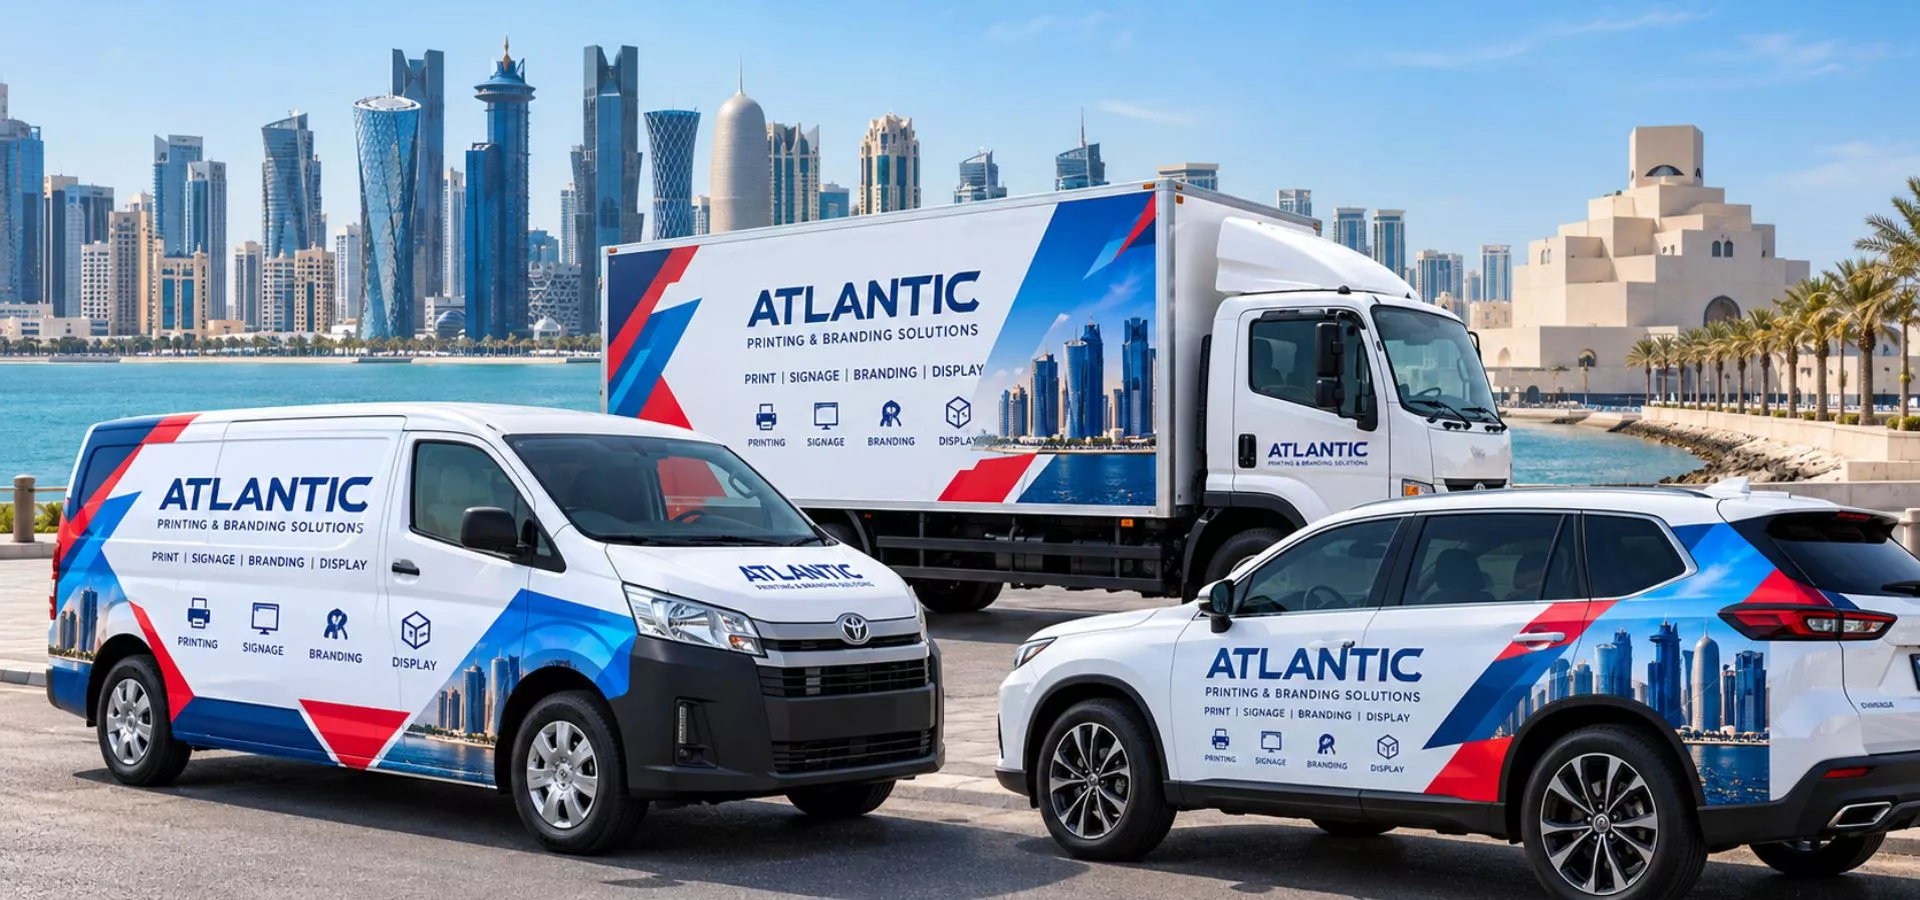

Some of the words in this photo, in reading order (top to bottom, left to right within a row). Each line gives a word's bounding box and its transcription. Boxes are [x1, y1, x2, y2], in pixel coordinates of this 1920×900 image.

[747, 270, 981, 328] ATLANTIC
[747, 335, 805, 349] PRINTING
[809, 334, 818, 346] &
[823, 329, 892, 345] BRANDING
[898, 324, 978, 340] SOLUTIONS
[745, 373, 776, 385] PRINT
[790, 370, 840, 383] SIGNAGE
[853, 366, 917, 380] BRANDING
[932, 364, 984, 378] DISPLAY
[748, 438, 786, 447] PRINTING
[807, 438, 845, 447] SIGNAGE
[868, 437, 915, 447] BRANDING
[939, 436, 977, 446] DISPLAY
[1268, 442, 1368, 458] ATLANTIC
[159, 477, 373, 512] ATLANTIC
[157, 519, 207, 530] PRINTING
[212, 520, 219, 530] &
[224, 520, 286, 532] BRANDING
[291, 521, 364, 534] SOLUTIONS
[152, 552, 179, 562] PRINT
[192, 553, 235, 565] SIGNAGE
[249, 555, 305, 568] BRANDING
[320, 558, 368, 571] DISPLAY
[739, 564, 863, 582] ATLANTIC
[178, 636, 218, 649] PRINTING
[243, 642, 284, 656] SIGNAGE
[309, 649, 363, 664] BRANDING
[392, 657, 437, 671] DISPLAY
[1206, 647, 1424, 682] ATLANTIC
[1205, 686, 1258, 698] PRINTING
[1262, 688, 1270, 698] &
[1275, 688, 1340, 700] BRANDING
[1345, 690, 1421, 703] SOLUTIONS
[1204, 707, 1231, 716] PRINT
[1243, 707, 1285, 718] SIGNAGE
[1299, 709, 1351, 720] BRANDING
[1366, 712, 1410, 723] DISPLAY
[1205, 754, 1236, 763] PRINTING
[1255, 757, 1286, 766] SIGNAGE
[1306, 760, 1347, 770] BRANDING
[1370, 764, 1405, 773] DISPLAY
